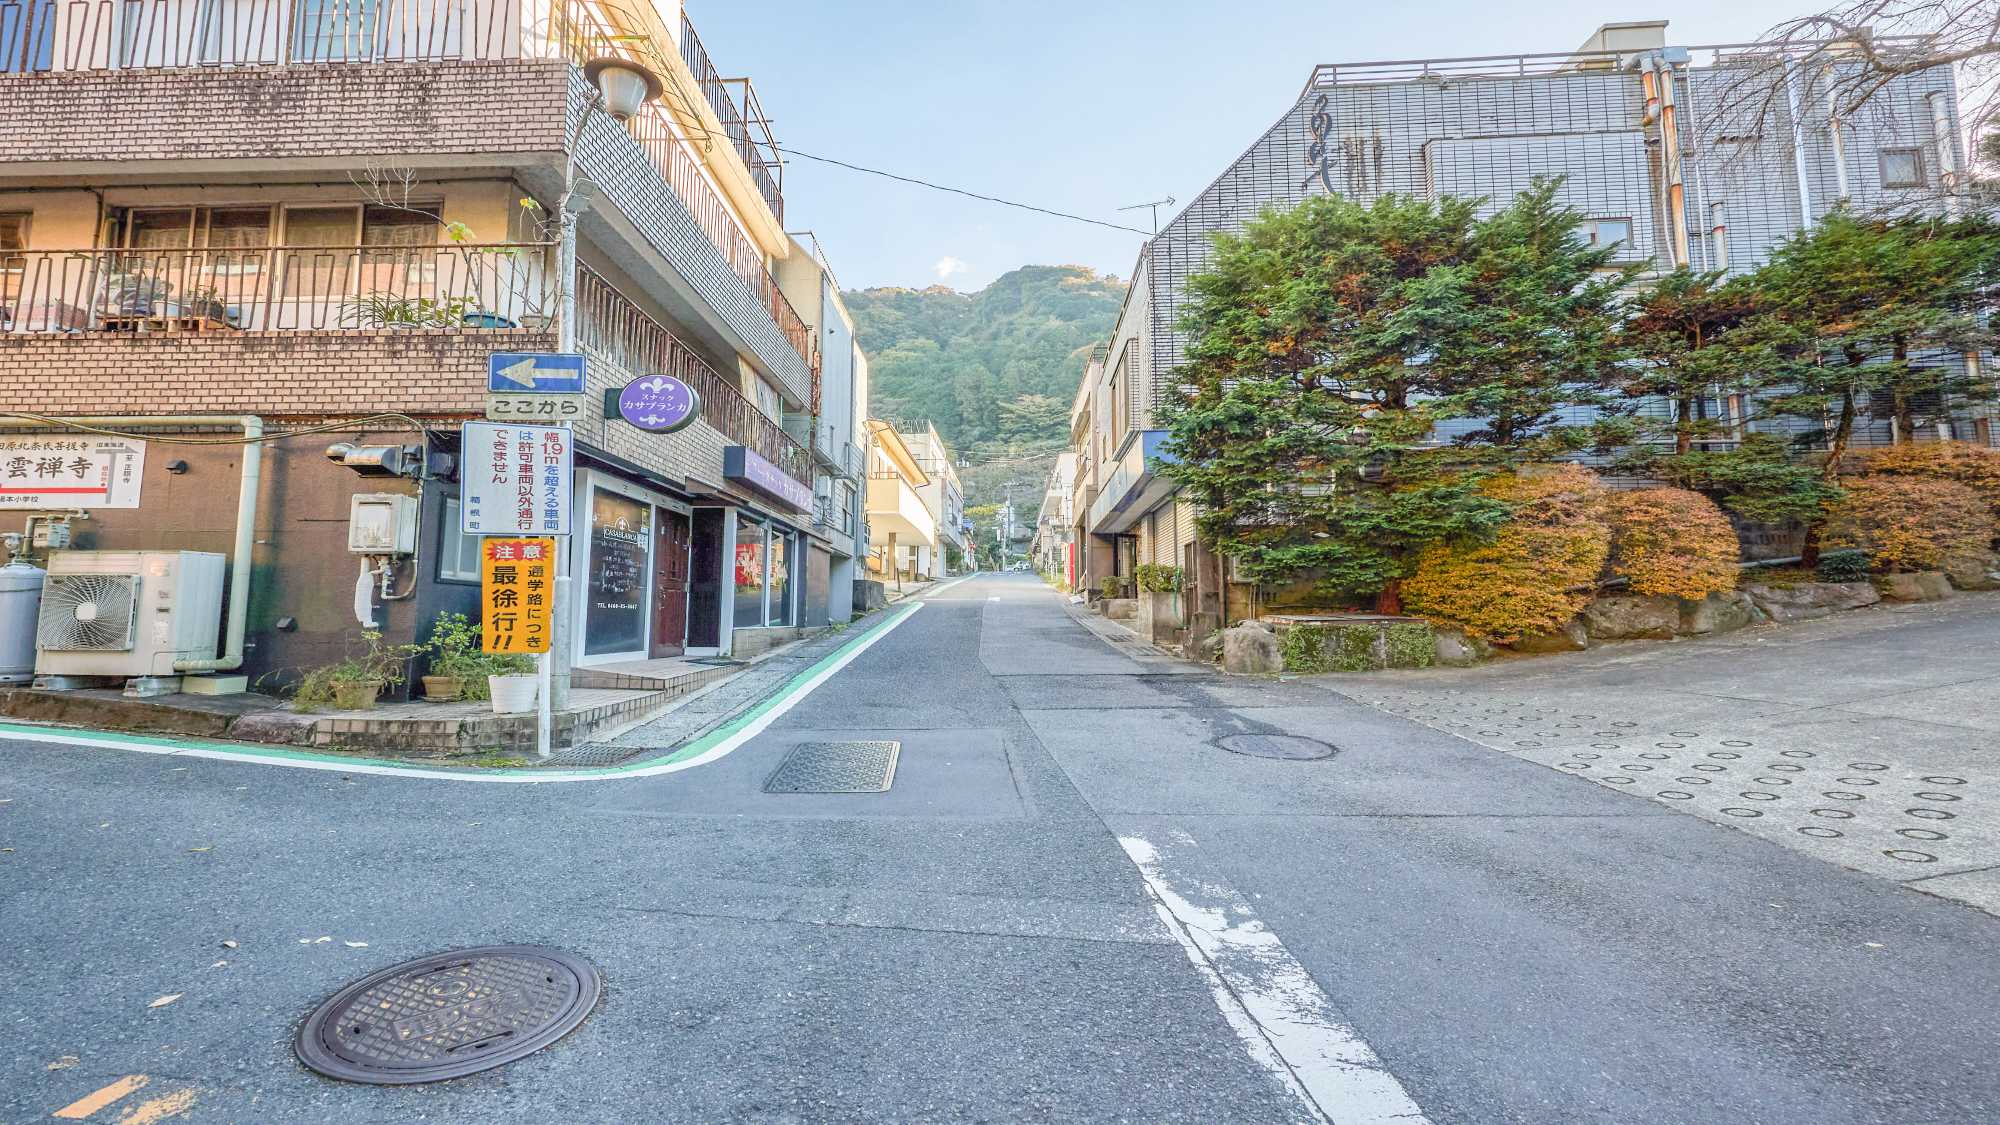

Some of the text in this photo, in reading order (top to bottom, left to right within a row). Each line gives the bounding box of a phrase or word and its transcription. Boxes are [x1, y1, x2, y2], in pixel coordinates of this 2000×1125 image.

[623, 400, 687, 412] カサブランカ
[641, 393, 674, 401] スナック
[494, 400, 579, 415] ここから
[491, 429, 509, 485] できません
[0, 456, 94, 479] 雲禅寺
[517, 430, 535, 531] は許可車両以外通行
[495, 545, 541, 559] 注意
[526, 565, 544, 648] 通学路につき
